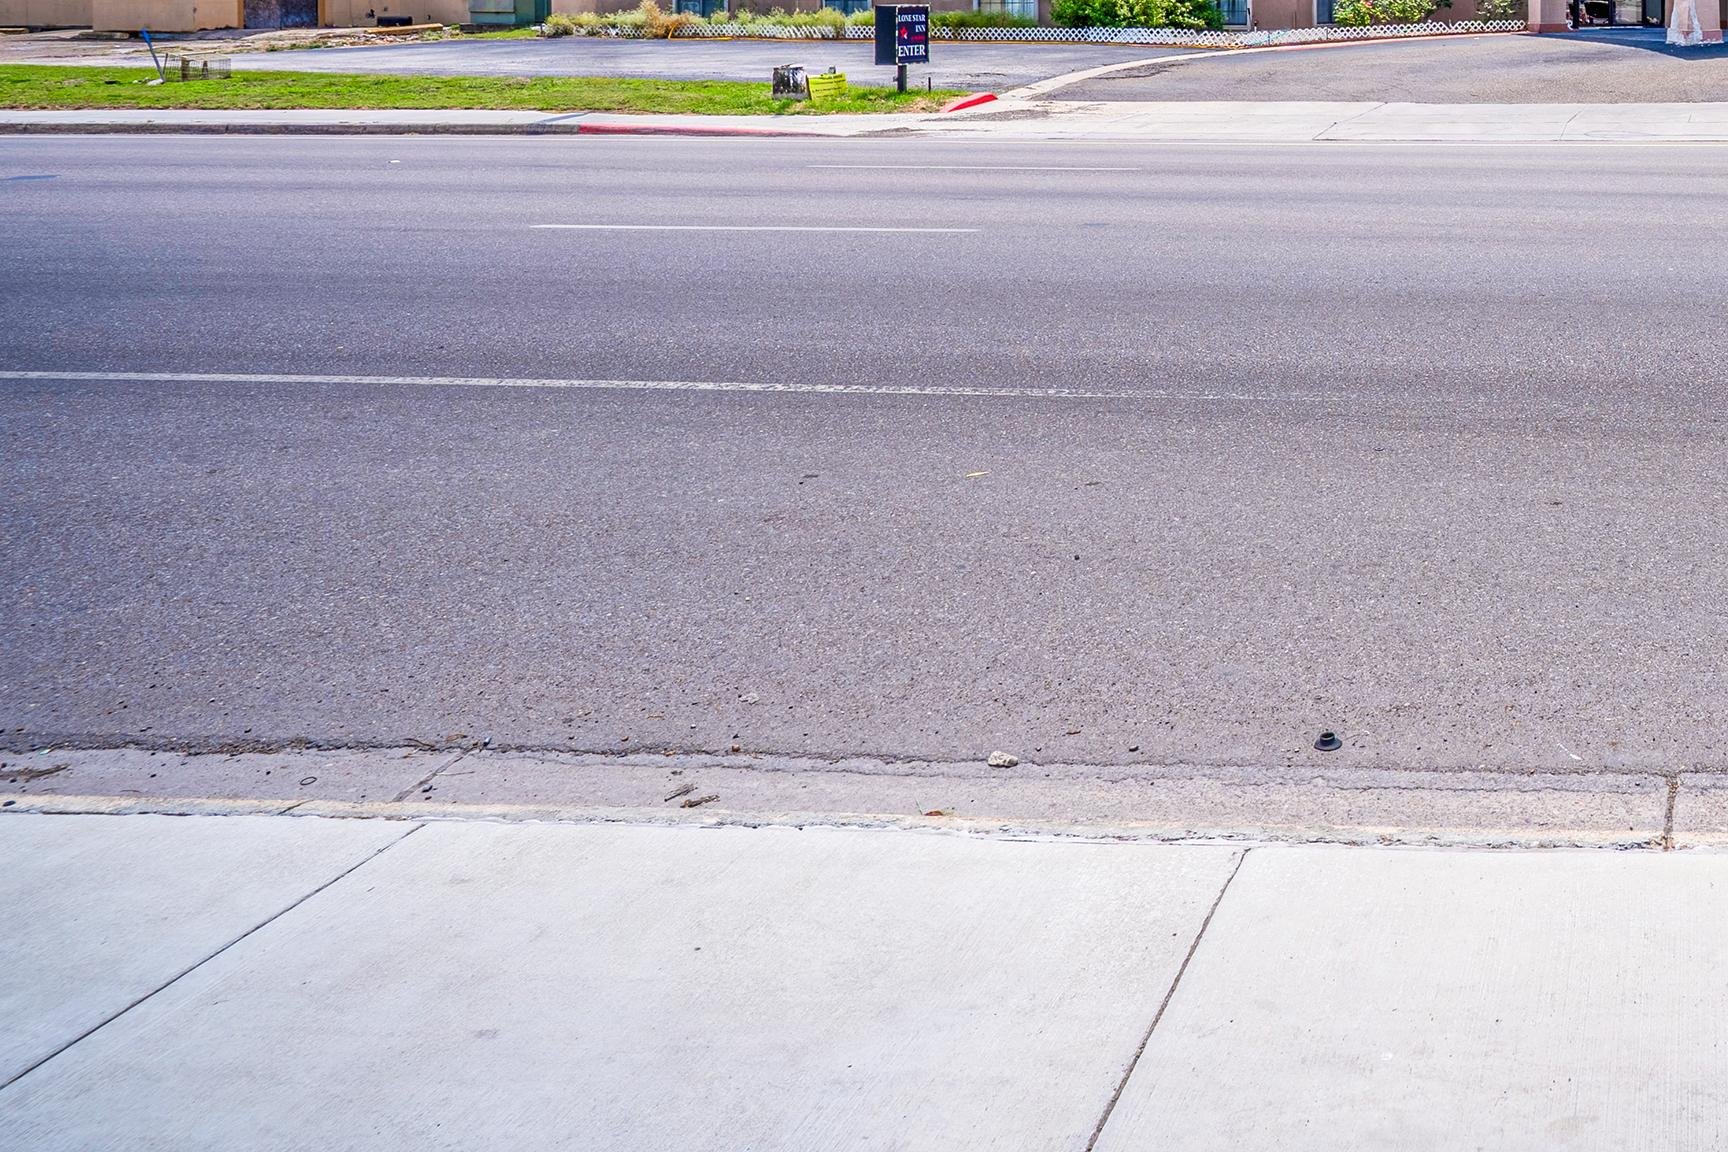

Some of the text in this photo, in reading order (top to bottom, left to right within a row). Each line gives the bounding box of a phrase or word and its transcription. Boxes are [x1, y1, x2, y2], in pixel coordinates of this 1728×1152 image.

[898, 14, 926, 22] LONE STAR
[915, 24, 926, 32] INN
[898, 44, 926, 57] ENTER
